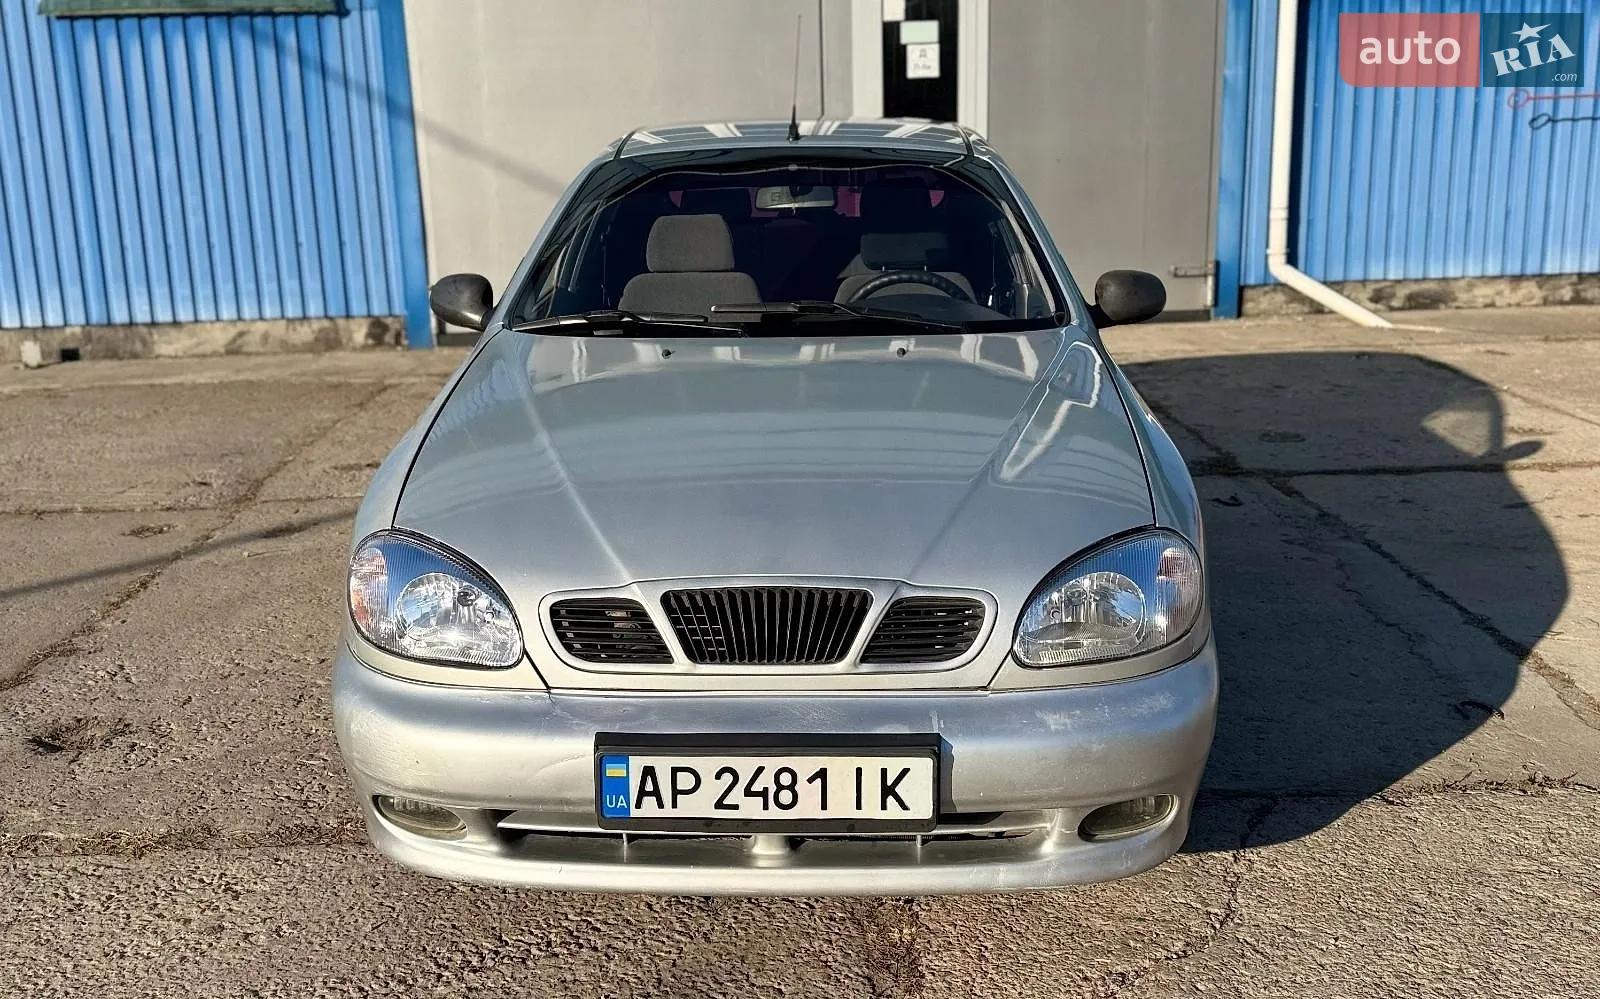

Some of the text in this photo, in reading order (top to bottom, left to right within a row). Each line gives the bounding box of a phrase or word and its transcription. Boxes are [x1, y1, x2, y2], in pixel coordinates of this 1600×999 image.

[606, 795, 628, 809] UA
[634, 765, 702, 810] AP
[714, 766, 828, 811] 2481
